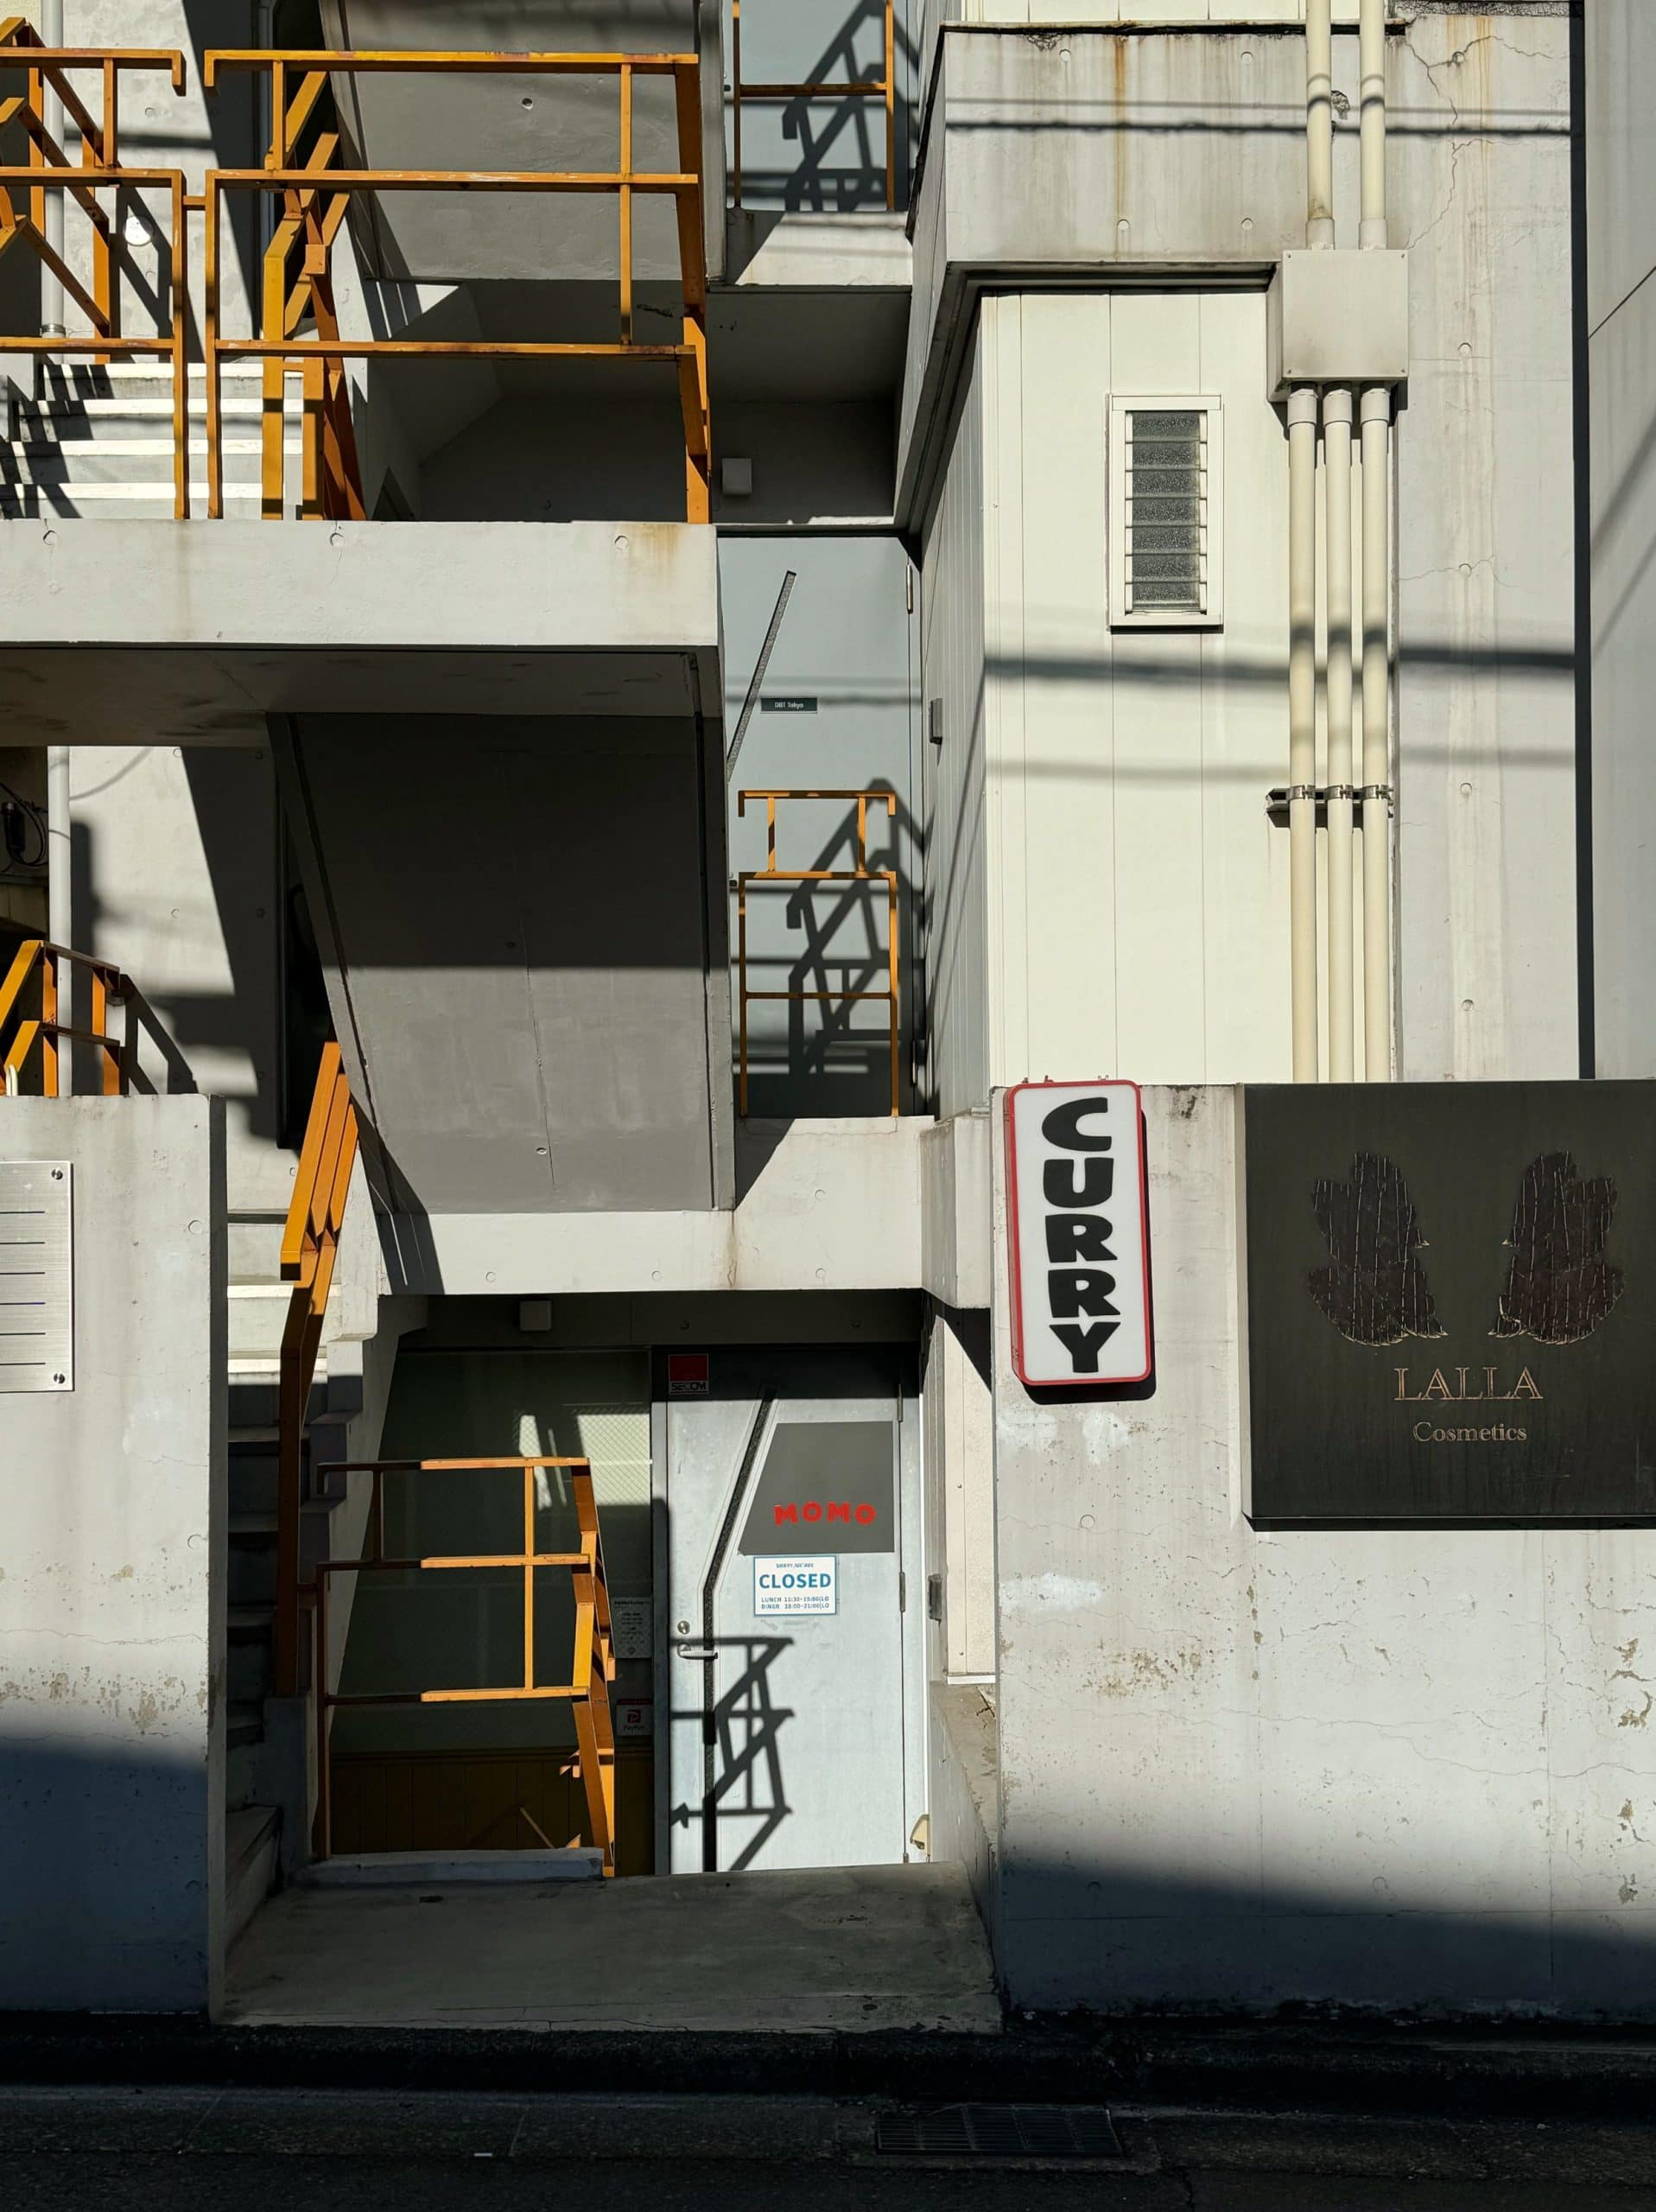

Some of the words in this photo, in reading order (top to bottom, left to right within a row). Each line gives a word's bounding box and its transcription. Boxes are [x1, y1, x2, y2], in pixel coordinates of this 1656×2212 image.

[1041, 1096, 1121, 1373] CURRY
[670, 1382, 706, 1390] SECOM
[1393, 1365, 1544, 1401] LALLA
[1412, 1421, 1527, 1442] Cosmetics
[774, 1501, 877, 1526] MOMO
[759, 1573, 831, 1588] CLOSED
